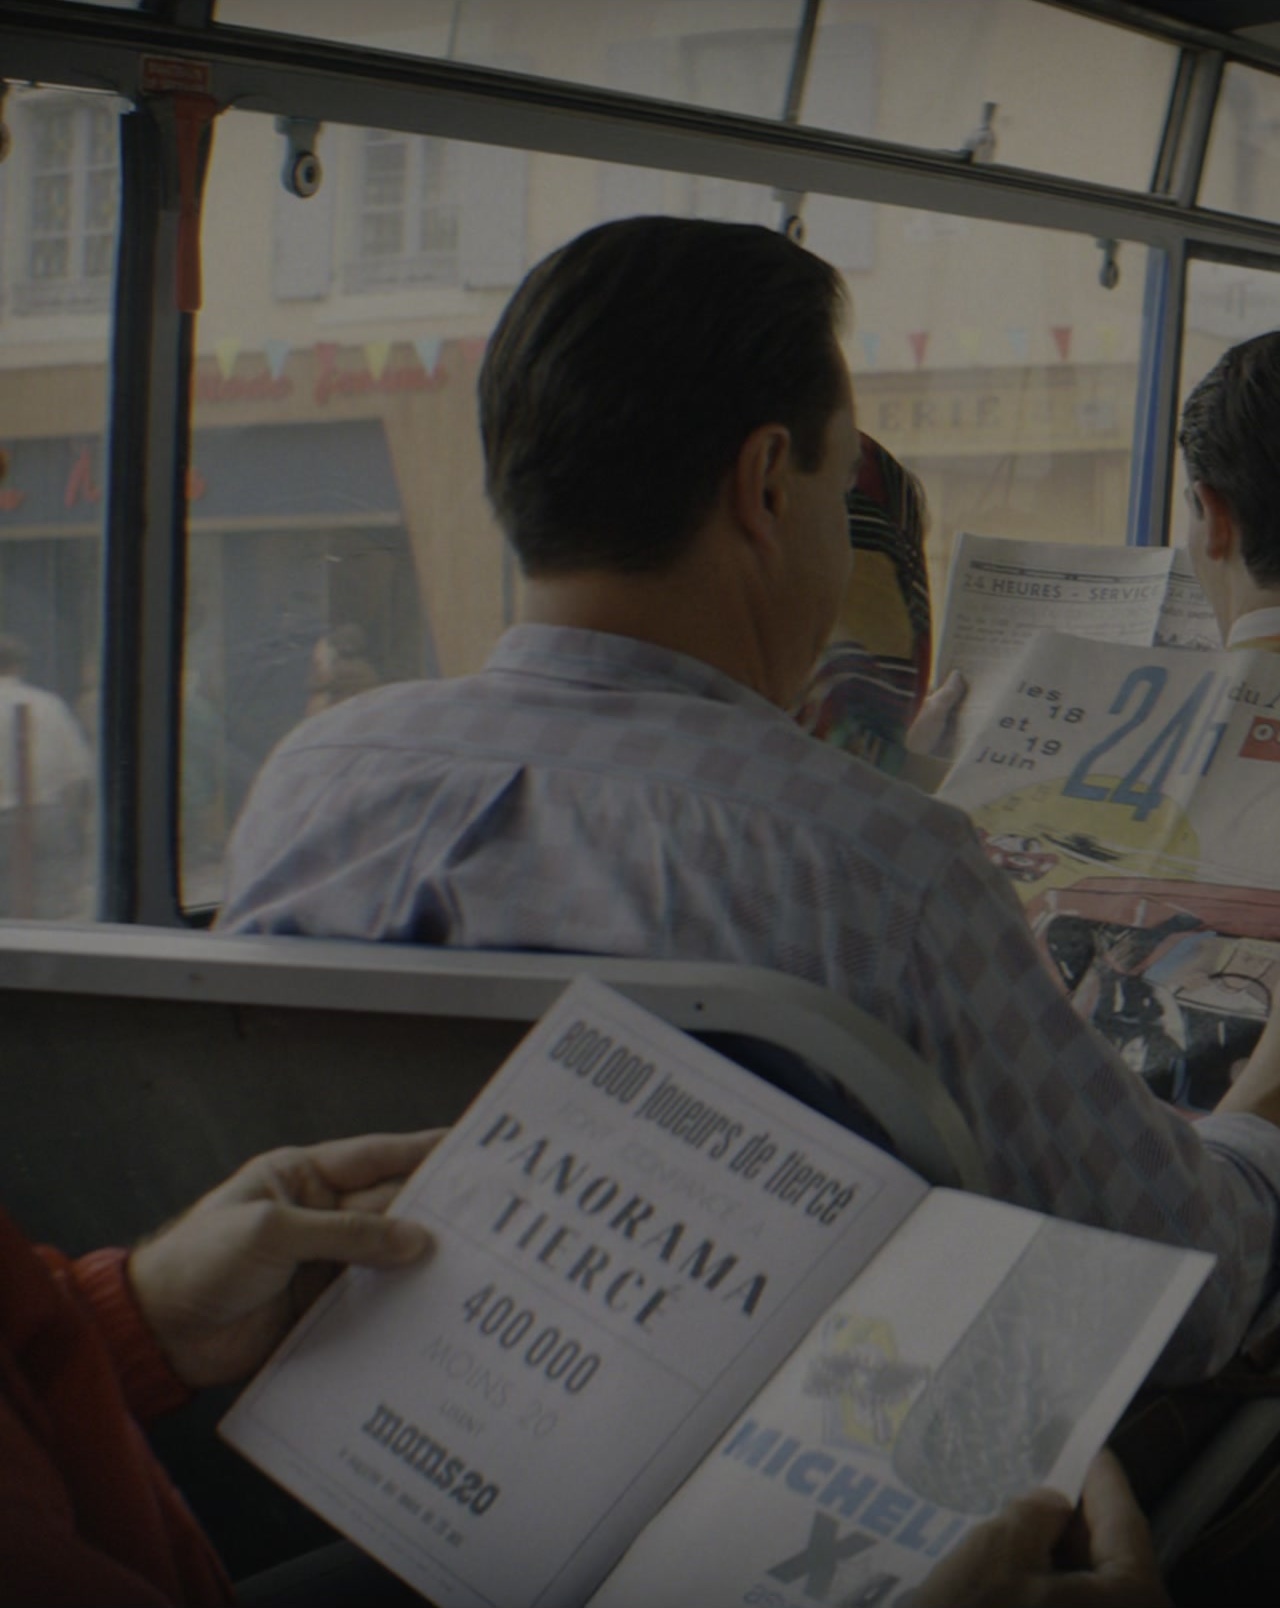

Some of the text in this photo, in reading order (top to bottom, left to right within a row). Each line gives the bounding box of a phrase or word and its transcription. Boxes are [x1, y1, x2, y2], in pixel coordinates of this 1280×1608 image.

[992, 580, 1062, 598] HEURES
[1016, 680, 1063, 702] les
[1228, 682, 1262, 706] du
[999, 715, 1032, 732] et
[1048, 705, 1087, 725] 18
[975, 746, 1038, 771] juin
[1025, 736, 1064, 757] 19
[634, 1072, 744, 1161] joueurs
[729, 1131, 778, 1181] de
[763, 1148, 860, 1228] tiercé
[478, 1111, 769, 1318] PANORAMA
[491, 1194, 684, 1333] TIERCÉ
[420, 1335, 517, 1408] MOINS
[721, 1417, 966, 1559] MICHELI
